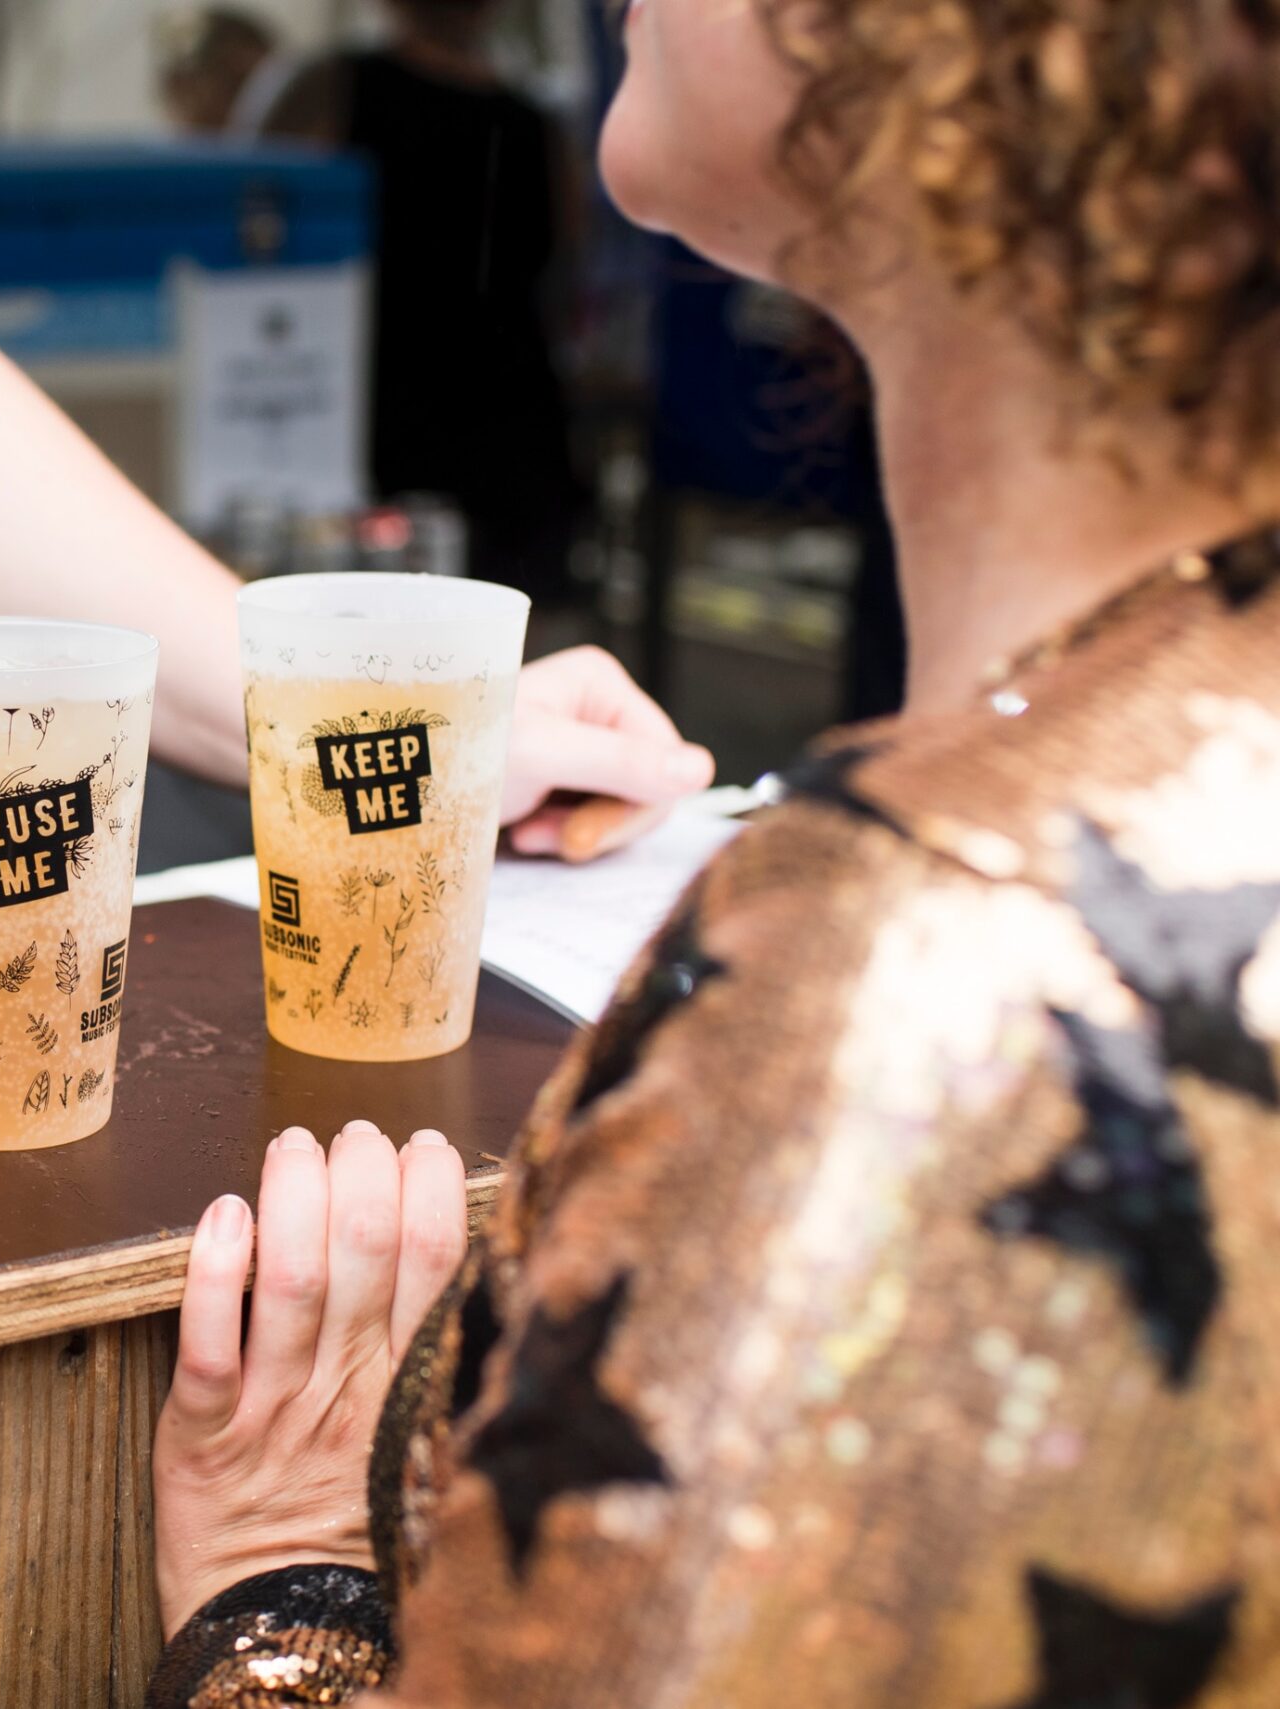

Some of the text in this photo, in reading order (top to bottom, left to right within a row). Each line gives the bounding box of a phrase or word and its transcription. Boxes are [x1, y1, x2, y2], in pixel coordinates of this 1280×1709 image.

[329, 735, 421, 780] KEEP
[356, 783, 410, 824] ME
[0, 850, 55, 897] ME
[81, 1025, 104, 1043] MUSIC
